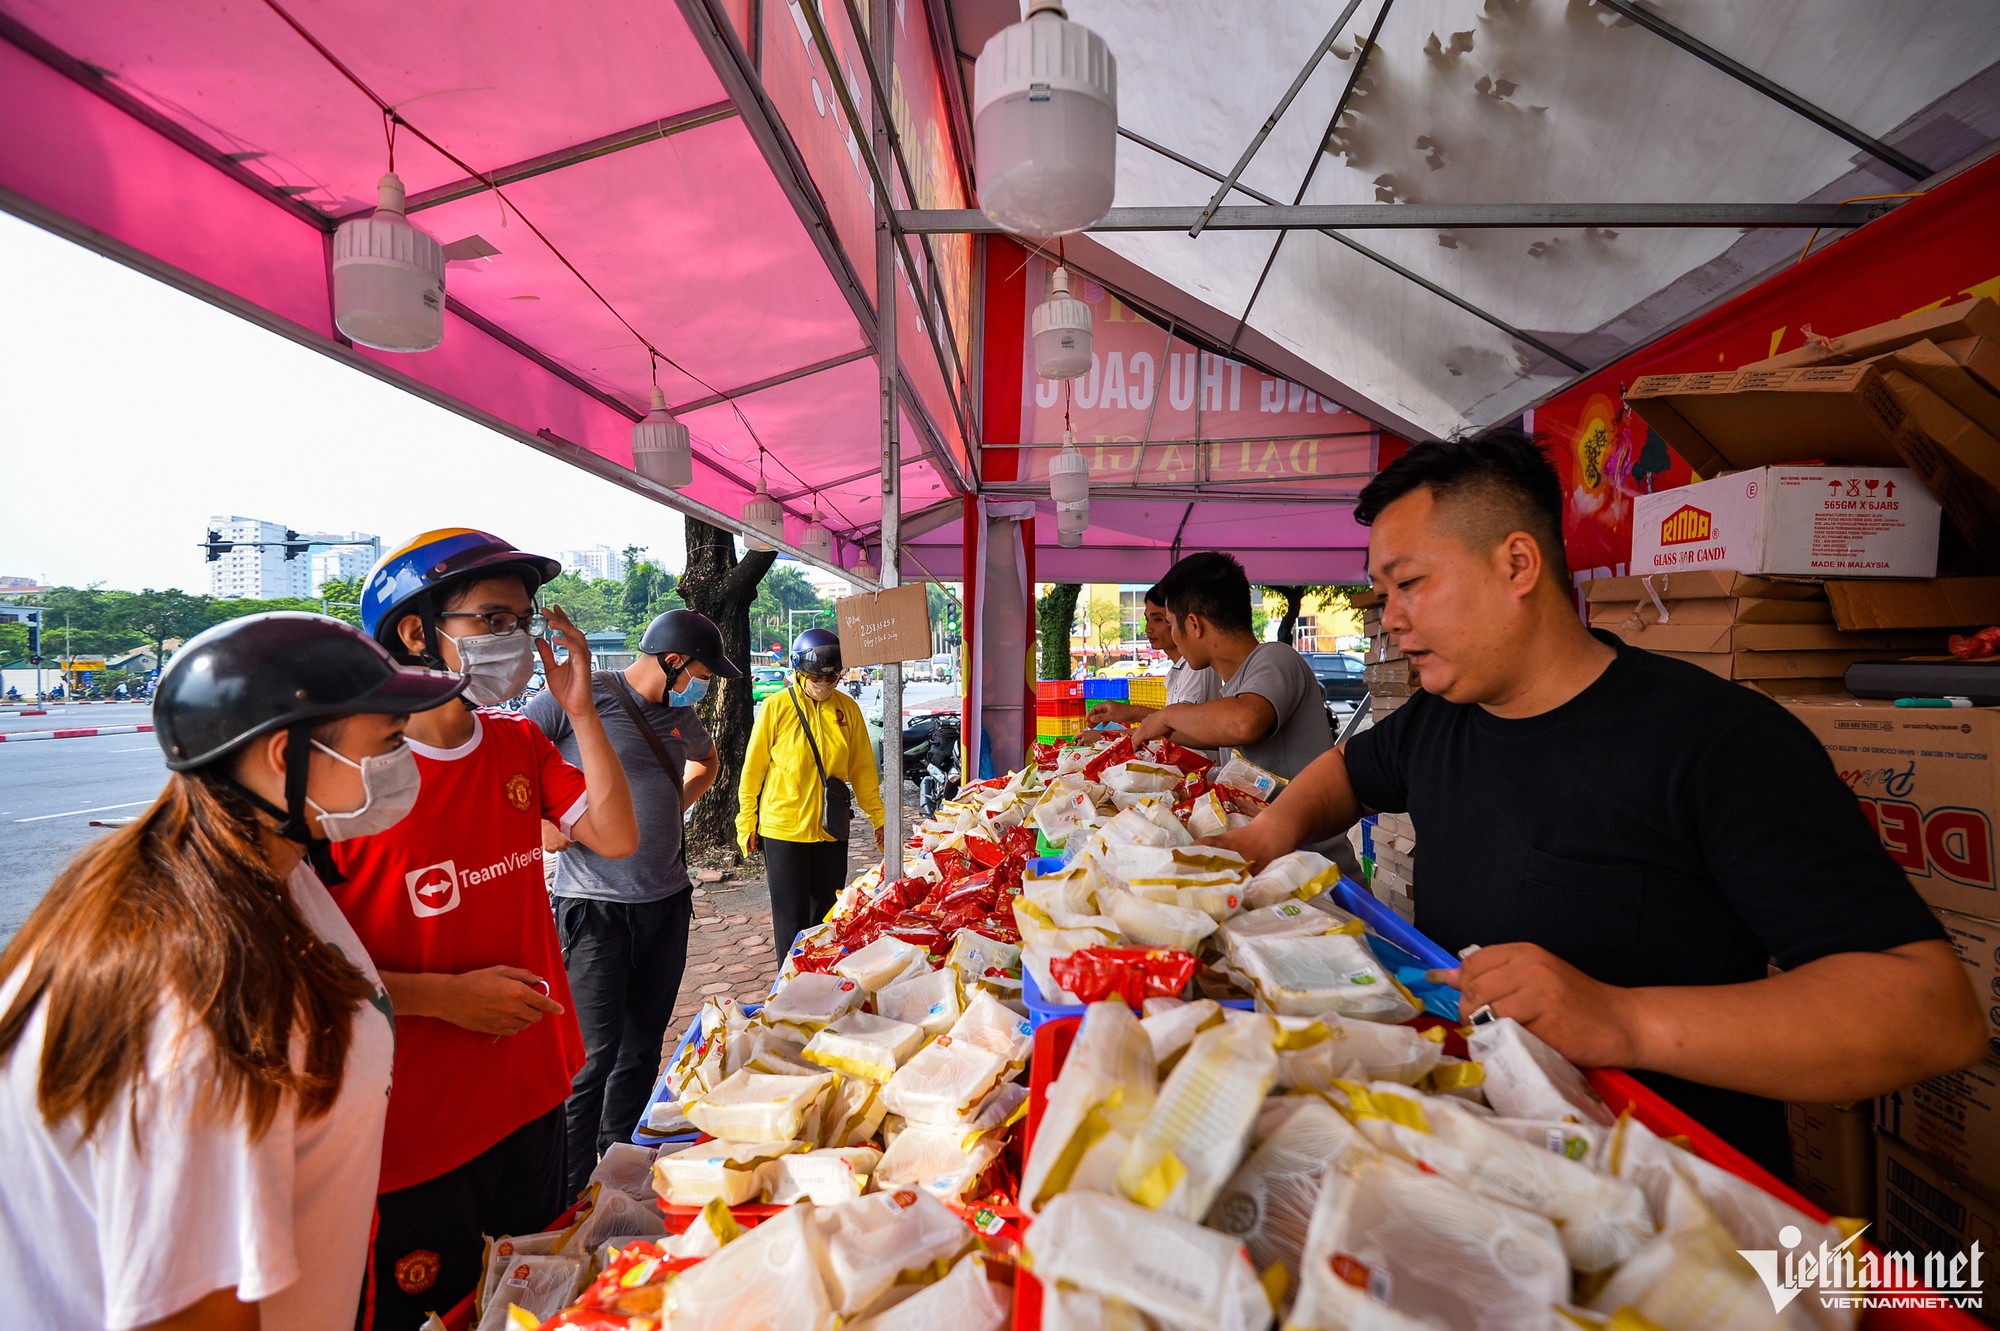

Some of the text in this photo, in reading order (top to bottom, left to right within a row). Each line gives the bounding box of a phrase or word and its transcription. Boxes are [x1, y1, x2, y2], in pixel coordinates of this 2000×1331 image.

[1824, 501, 1899, 510] 565GM X 6JARS
[1663, 510, 1709, 542] RINDA
[1654, 552, 1677, 566] GLASS
[1697, 546, 1727, 562] CANDY
[1840, 760, 1915, 796] Paris
